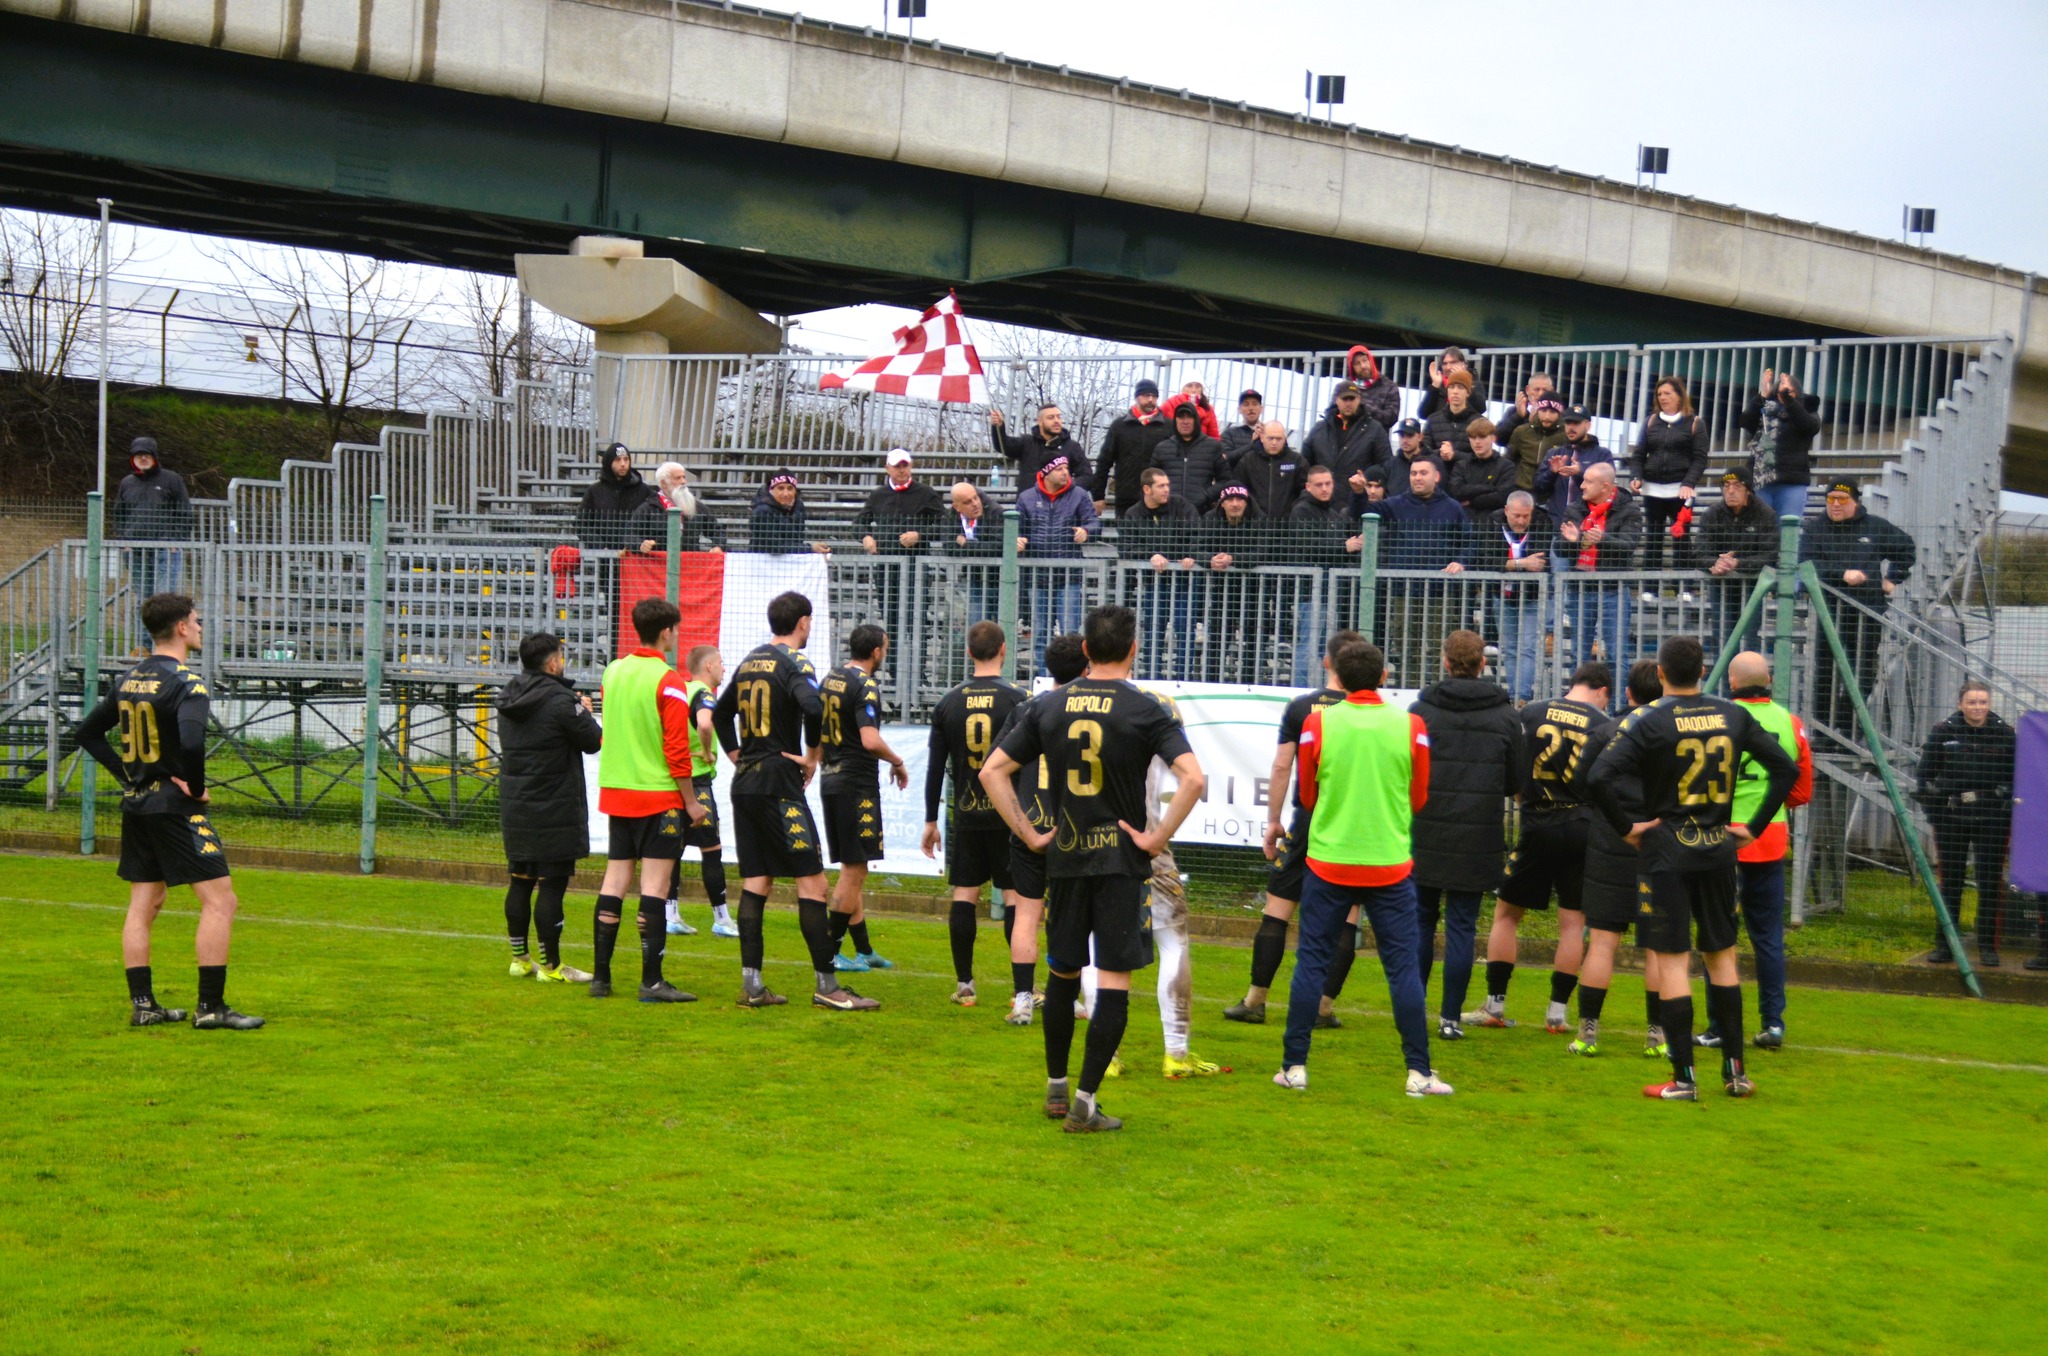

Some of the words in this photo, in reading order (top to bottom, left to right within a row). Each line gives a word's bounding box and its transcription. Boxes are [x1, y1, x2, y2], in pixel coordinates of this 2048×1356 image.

[737, 679, 771, 738] 50
[966, 695, 994, 709] BANFI
[1065, 696, 1113, 713] ROPOLO
[1546, 708, 1591, 728] FERRIERI
[1675, 714, 1727, 732] DAQOUNE
[118, 700, 160, 763] 90
[965, 713, 991, 769] 9
[1067, 719, 1103, 796] 3
[1533, 724, 1588, 784] 27
[1675, 735, 1733, 805] 23
[1204, 818, 1269, 838] HOTE
